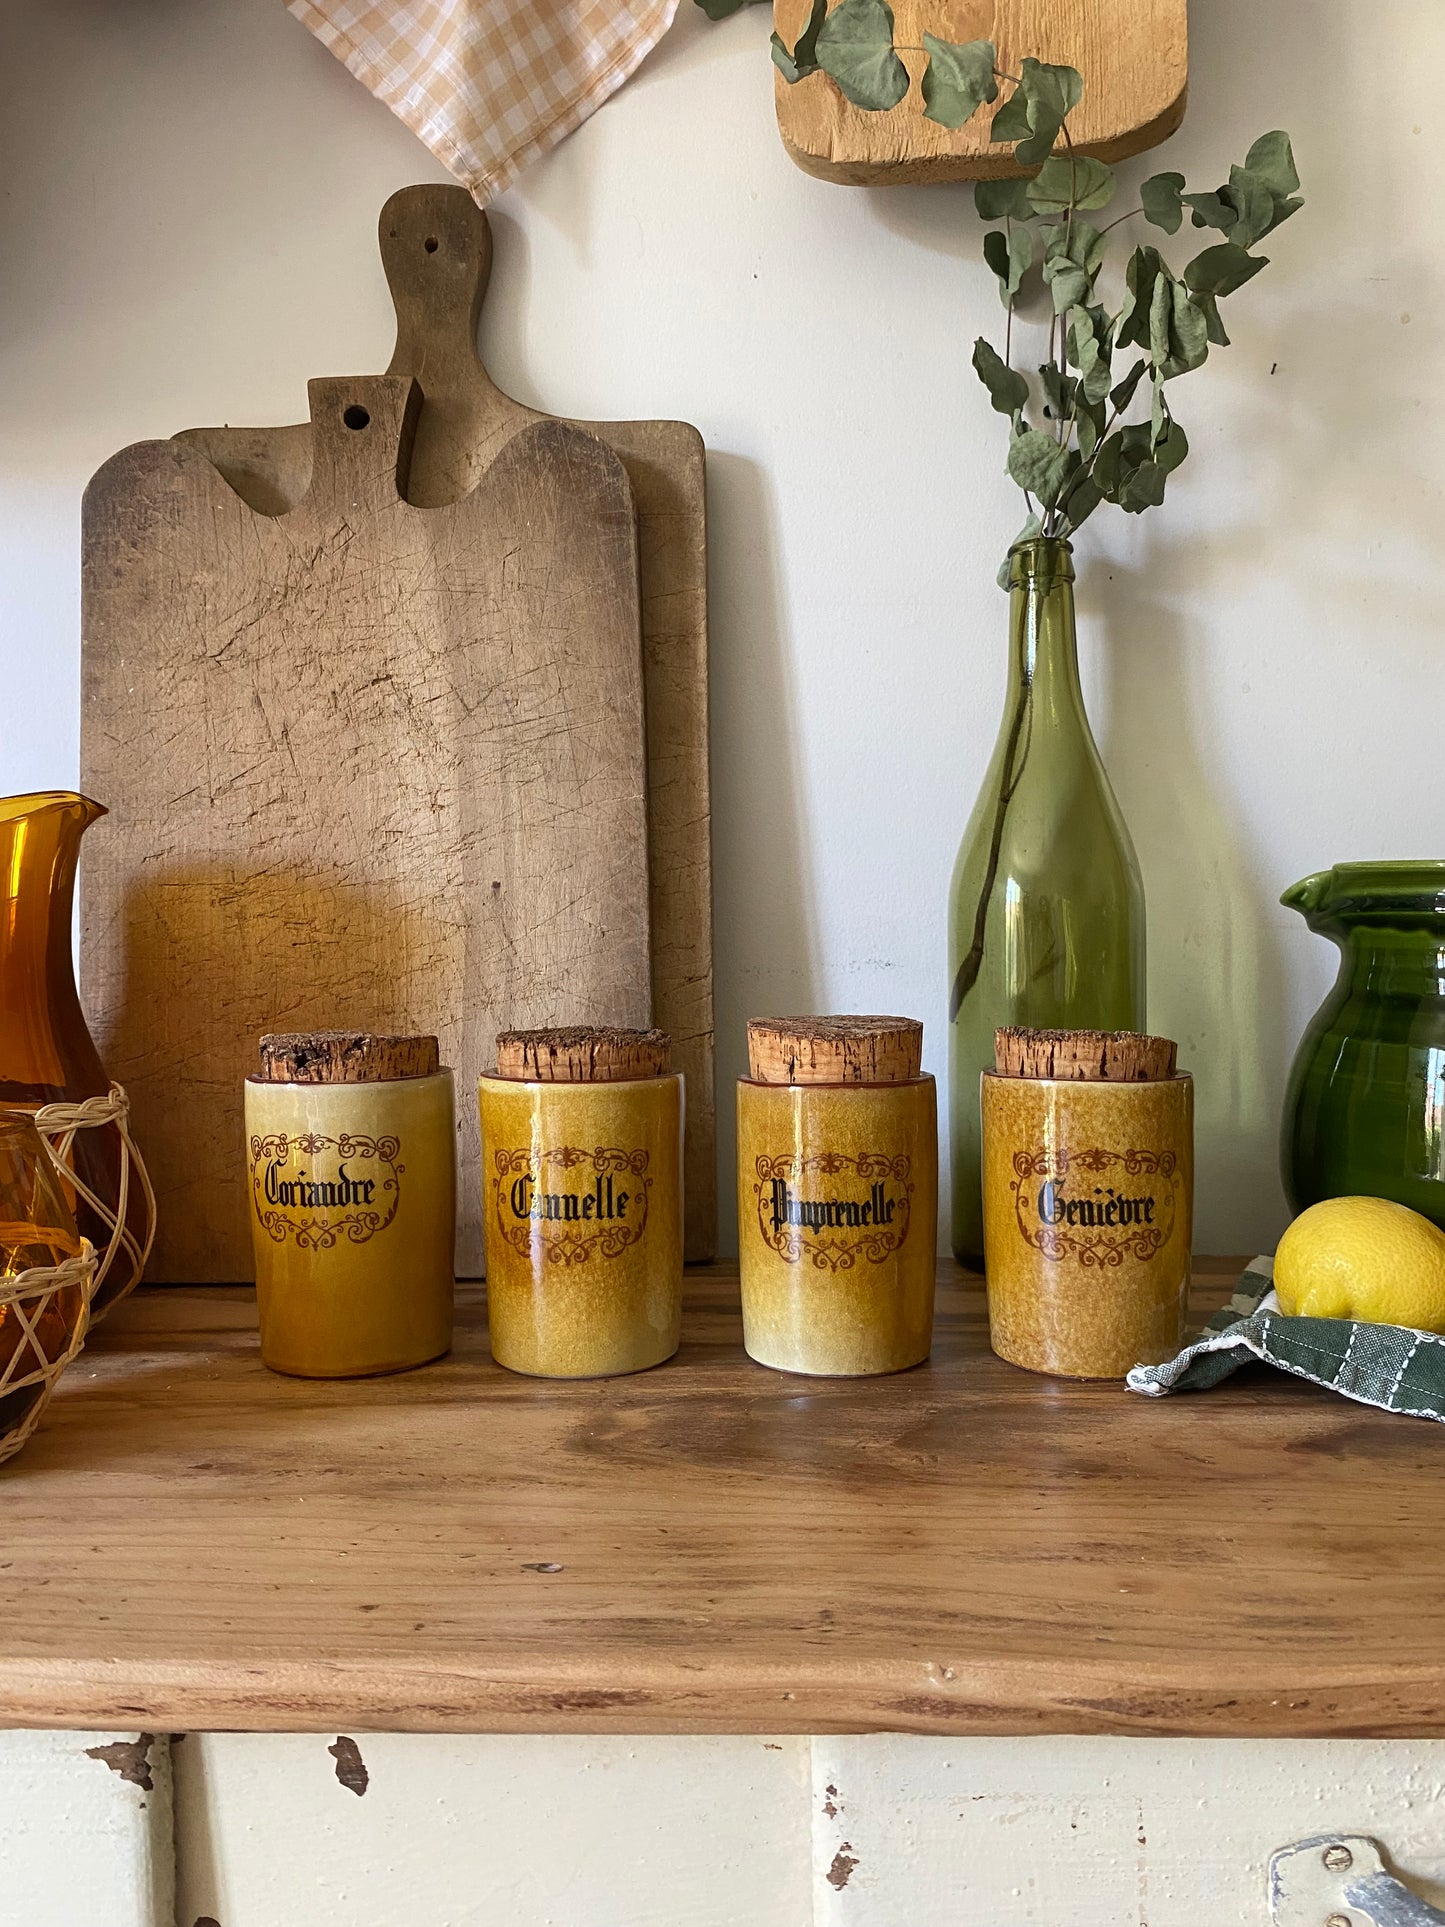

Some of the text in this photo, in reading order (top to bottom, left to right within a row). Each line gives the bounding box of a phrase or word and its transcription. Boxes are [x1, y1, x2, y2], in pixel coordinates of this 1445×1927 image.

[265, 1159, 375, 1208] Coriandre
[770, 1177, 896, 1236] Pimprenelle
[1037, 1178, 1156, 1227] Genièvre
